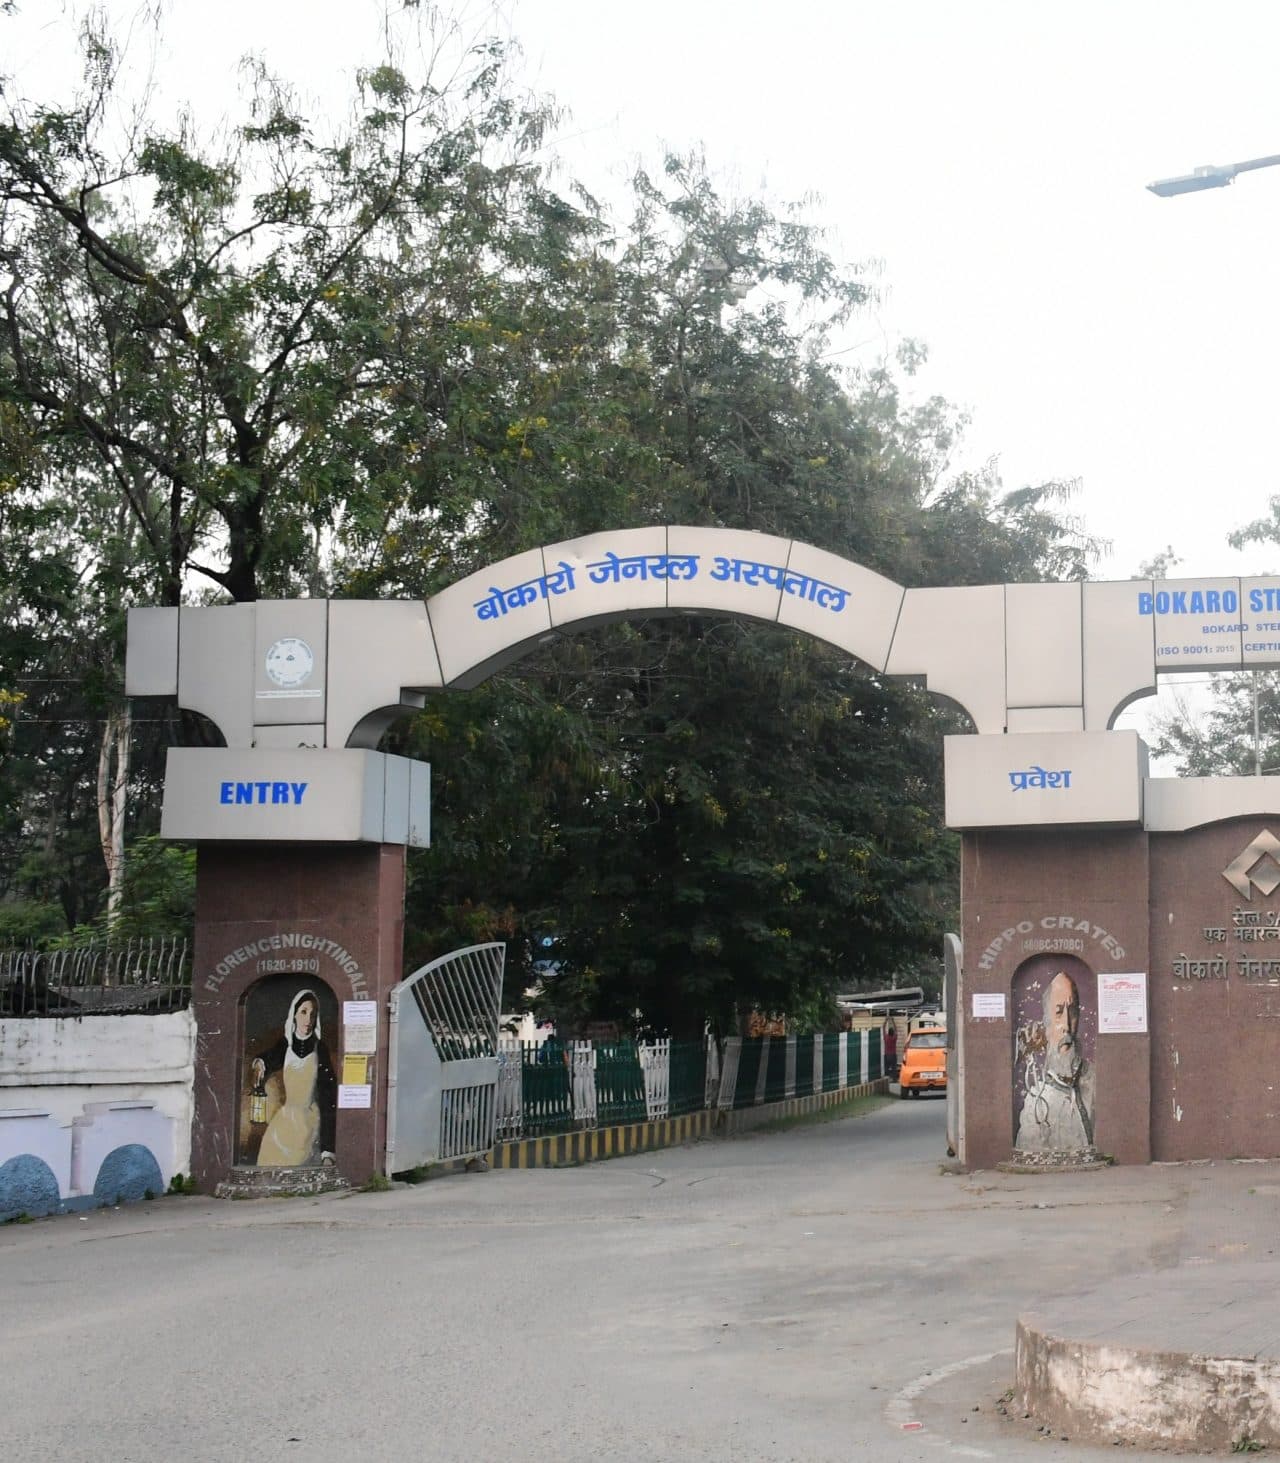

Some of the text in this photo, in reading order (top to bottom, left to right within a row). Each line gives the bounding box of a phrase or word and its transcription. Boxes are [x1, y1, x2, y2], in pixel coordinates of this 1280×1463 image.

[473, 552, 851, 621] बोकारो जेनरल अस्पताल
[1138, 590, 1237, 615] BOKARO
[1202, 624, 1249, 634] BOKARO
[1156, 646, 1180, 656] (ISO
[1008, 766, 1072, 792] प्रवेश
[219, 781, 309, 805] ENTRY
[978, 916, 1125, 970] HIPPO CRATES
[1203, 927, 1227, 942] एक
[256, 959, 320, 973] (1820-1910)
[1173, 952, 1229, 980] बोकारो
